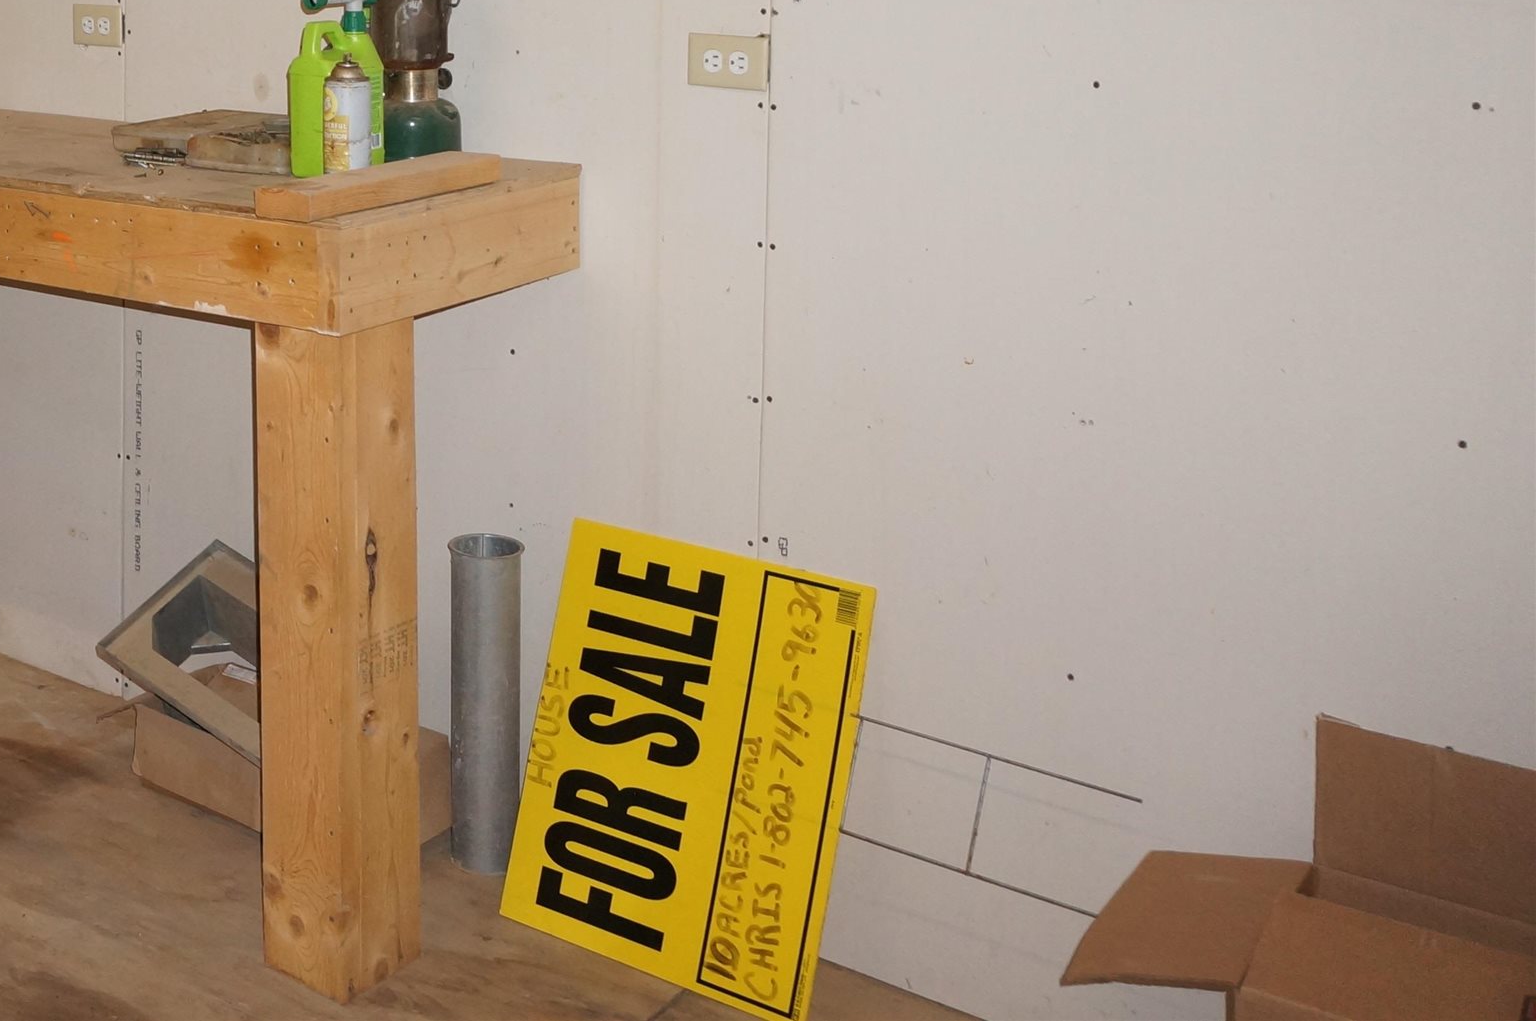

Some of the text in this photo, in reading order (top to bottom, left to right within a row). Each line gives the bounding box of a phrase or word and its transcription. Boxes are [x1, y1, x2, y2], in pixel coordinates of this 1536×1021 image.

[135, 329, 143, 346] GP
[135, 351, 143, 427] LITE-WEIGHT
[134, 483, 142, 529] CEILING
[134, 535, 142, 573] BOARD
[777, 536, 789, 557] GP
[526, 661, 570, 788] HOUSE
[535, 547, 726, 952] FOR SALE
[743, 882, 783, 1002] CHRIS
